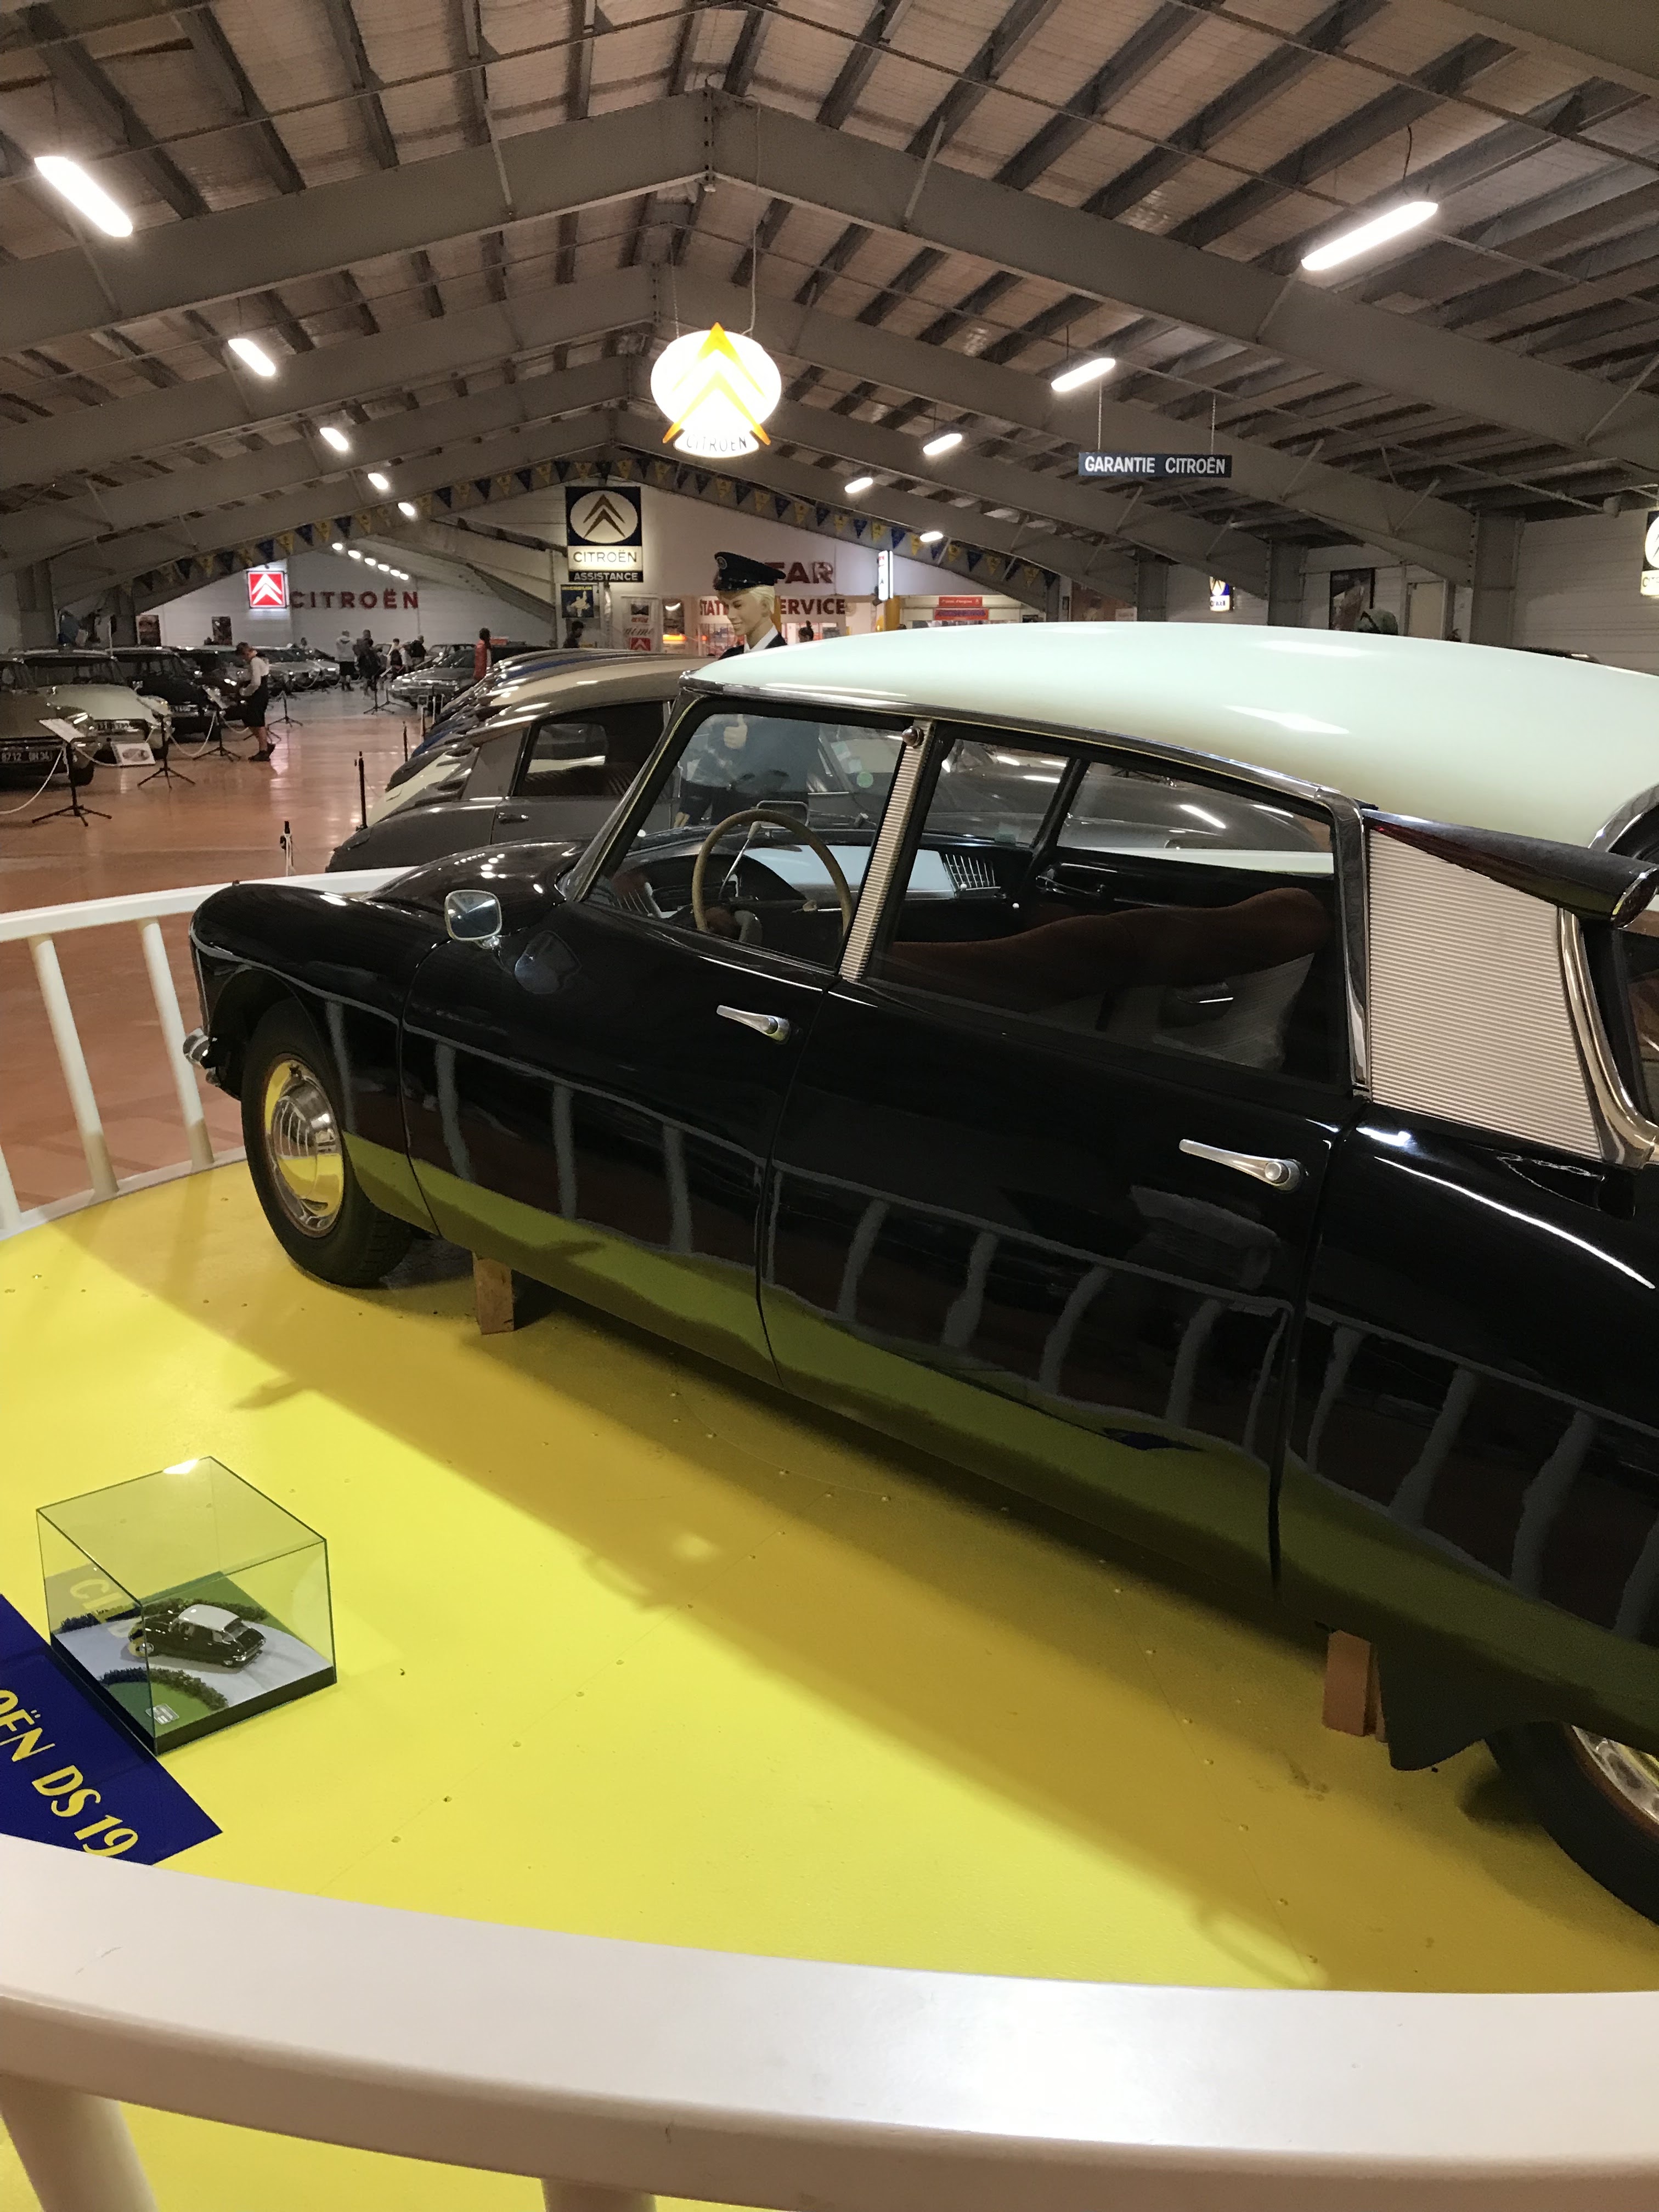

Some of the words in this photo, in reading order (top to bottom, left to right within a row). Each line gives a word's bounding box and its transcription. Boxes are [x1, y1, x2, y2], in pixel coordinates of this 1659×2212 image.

[1085, 456, 1155, 473] GARANTIE
[1165, 456, 1226, 474] CITROËN
[573, 549, 637, 563] CITROËN
[574, 572, 639, 581] ASSISTANCE
[289, 588, 419, 609] CITROËN
[32, 1765, 101, 1817] DS
[74, 1815, 139, 1857] 19
